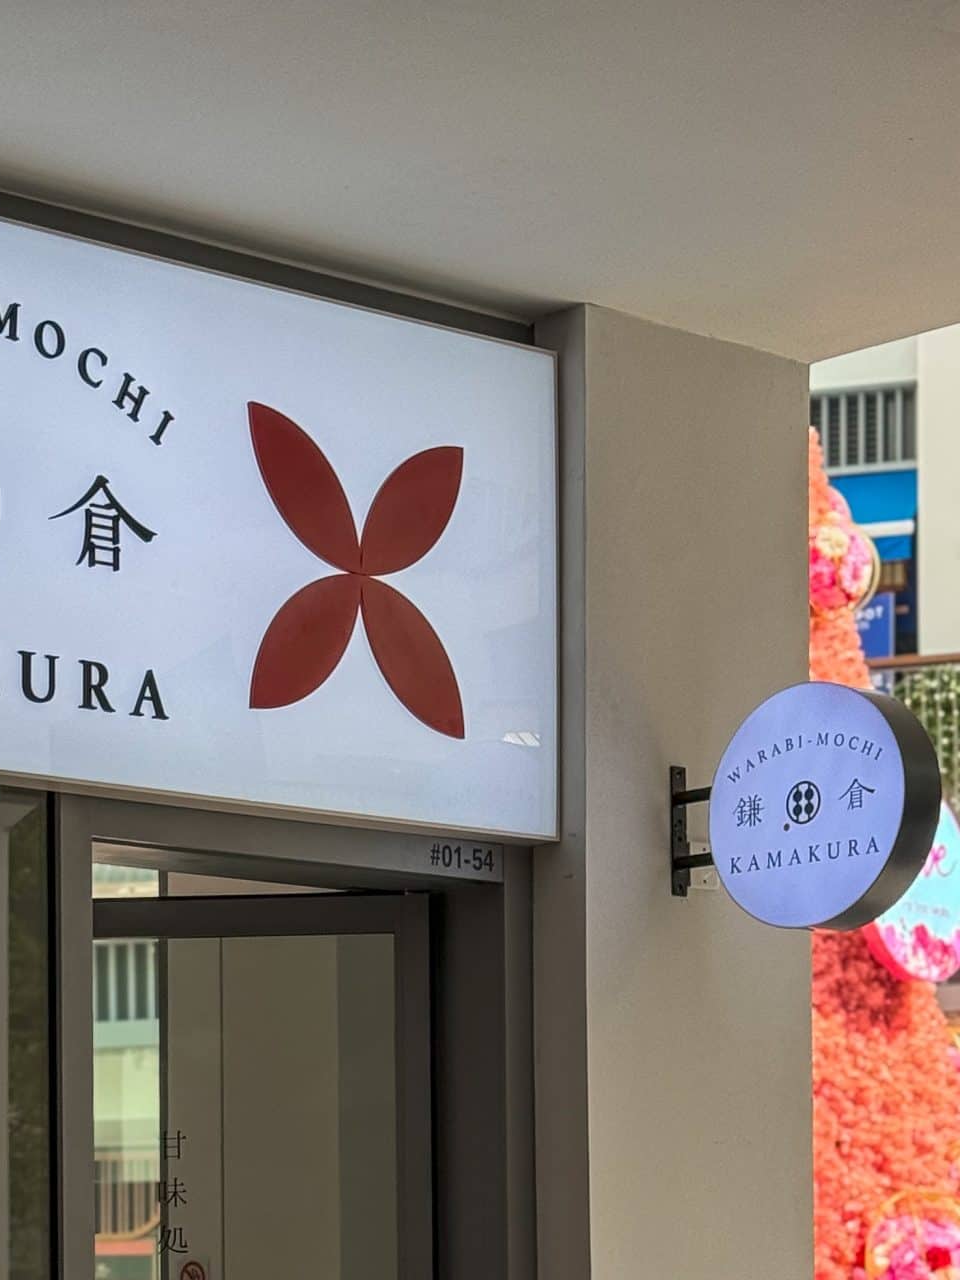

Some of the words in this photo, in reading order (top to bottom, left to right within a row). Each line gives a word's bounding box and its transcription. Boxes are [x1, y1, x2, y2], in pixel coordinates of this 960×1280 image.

[49, 475, 158, 572] 倉
[727, 732, 884, 784] WARABI-MOCHI
[733, 796, 765, 828] 鎌
[839, 777, 876, 810] 倉
[431, 842, 494, 873] #01-54
[729, 835, 880, 875] KAMAKURA
